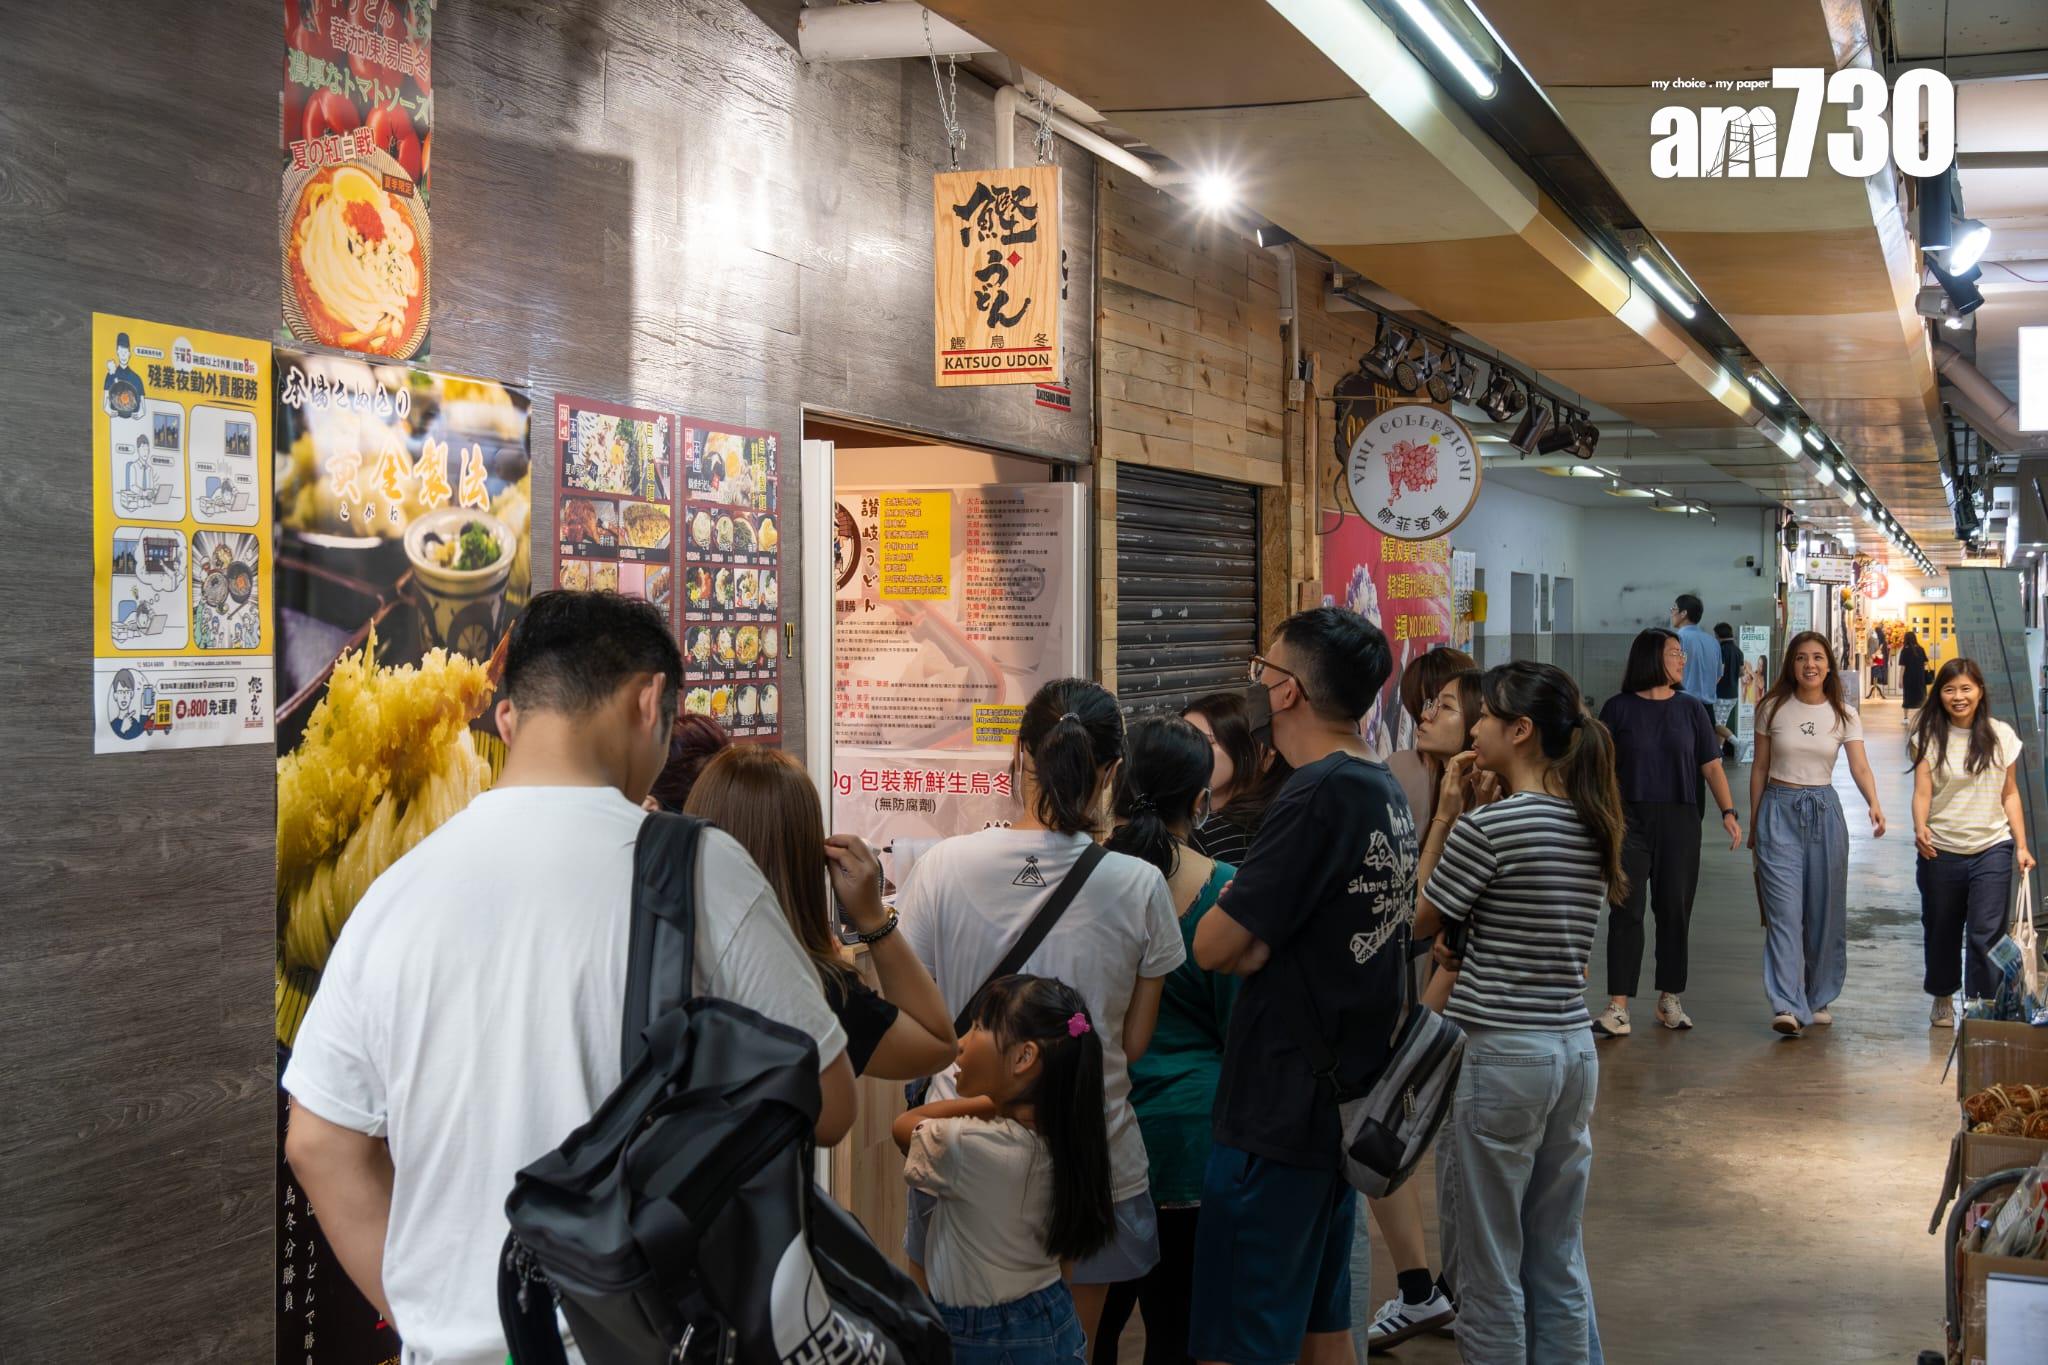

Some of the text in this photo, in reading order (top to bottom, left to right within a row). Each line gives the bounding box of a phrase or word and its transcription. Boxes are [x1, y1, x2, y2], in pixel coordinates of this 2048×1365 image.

[288, 48, 431, 127] 濃厚なトマトソース
[945, 353, 1049, 370] KATSUO UDON
[148, 365, 258, 400] 殘業夜勤外賣服務
[1354, 414, 1471, 486] VINI COLLEZIONI
[1348, 875, 1388, 894] Share
